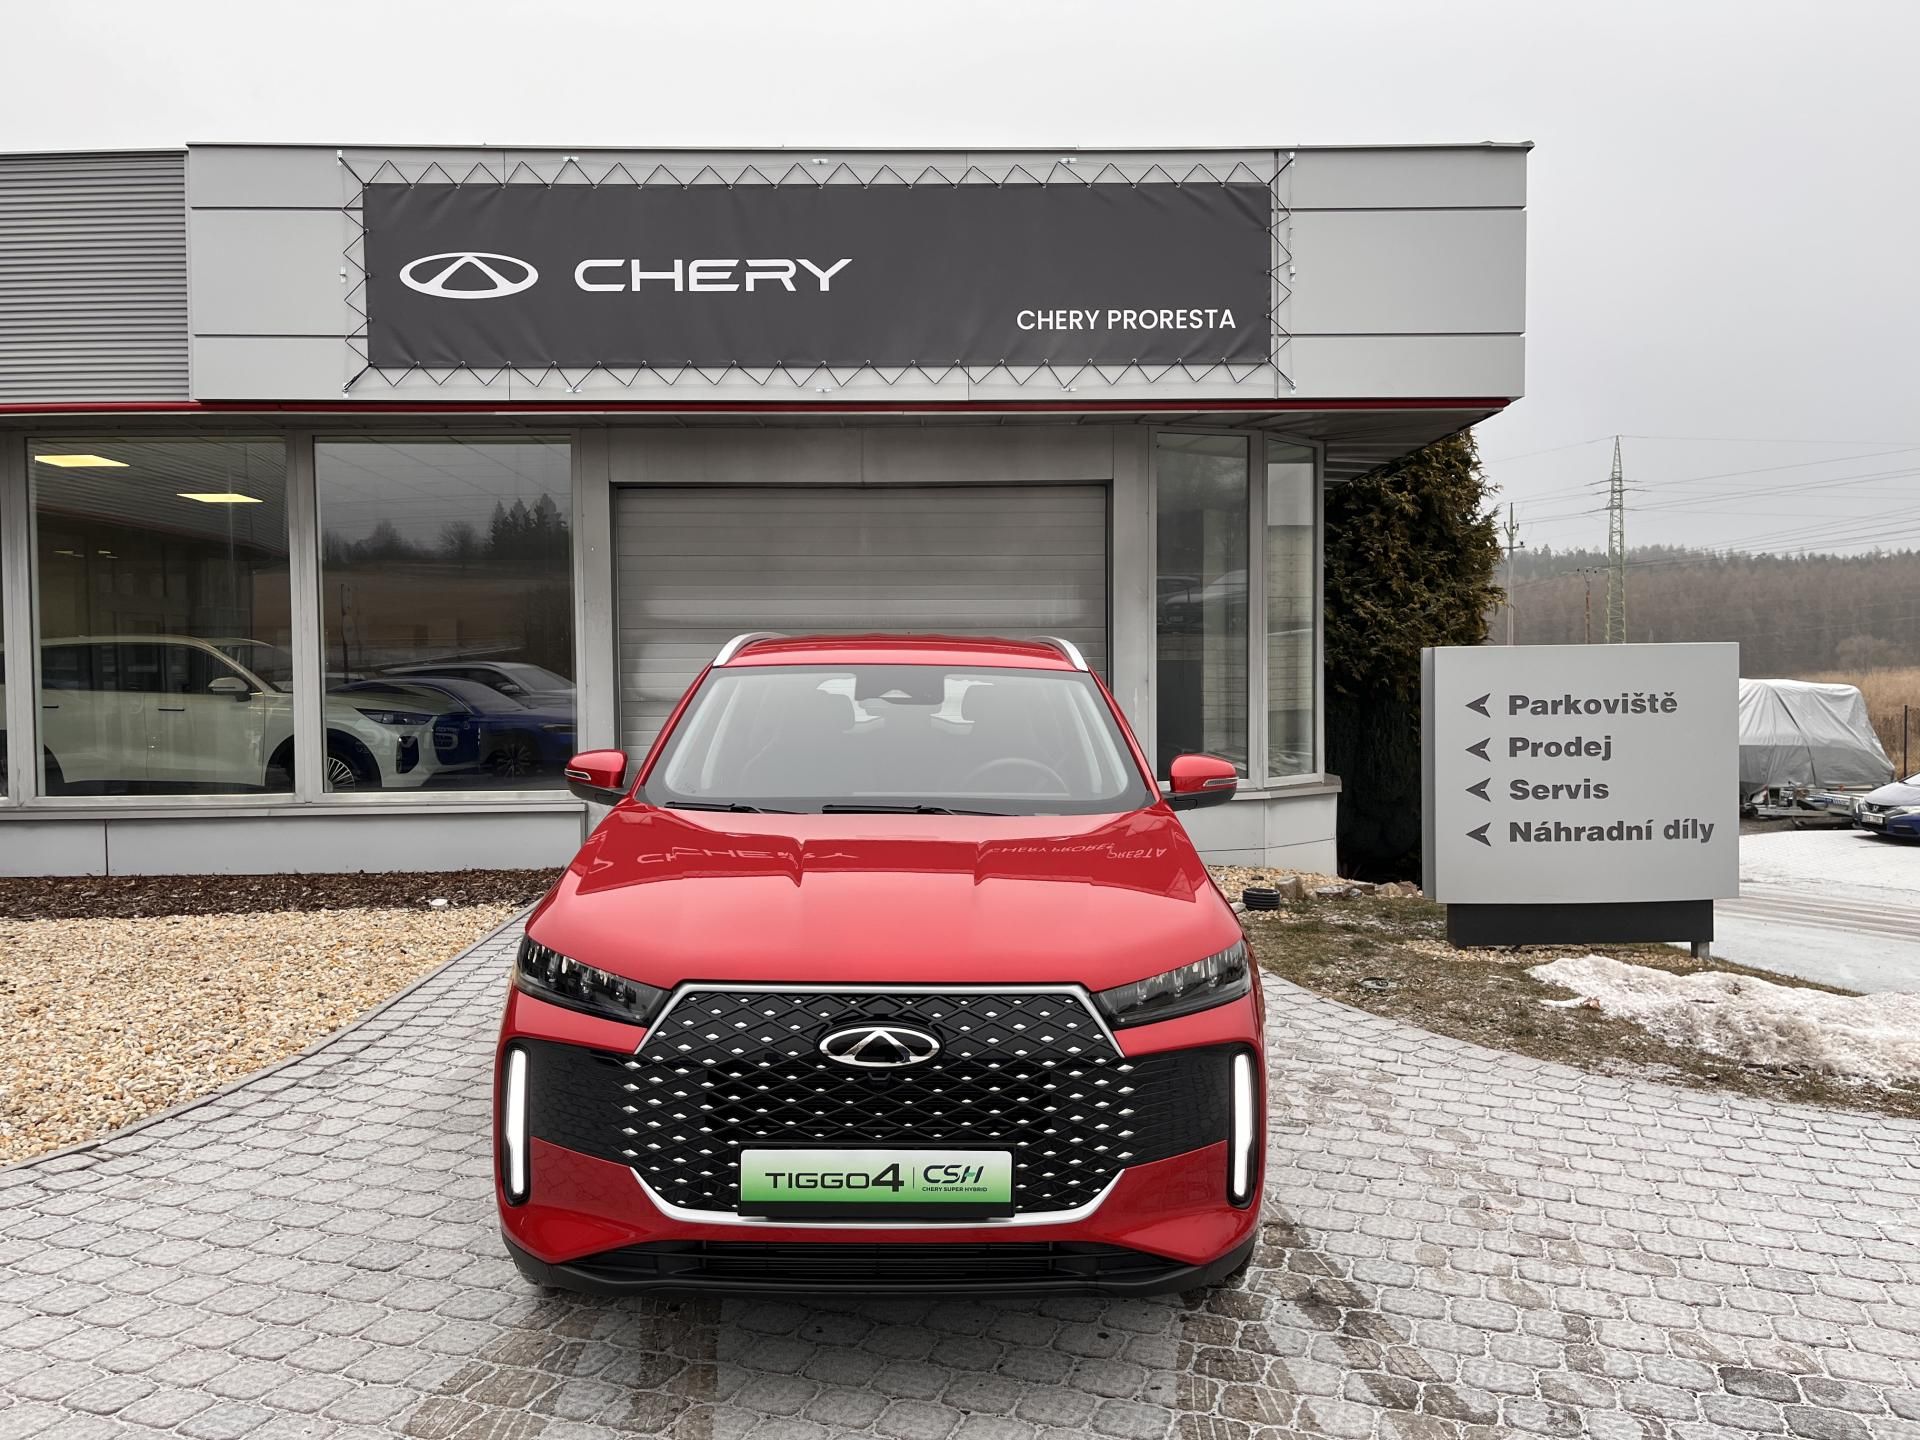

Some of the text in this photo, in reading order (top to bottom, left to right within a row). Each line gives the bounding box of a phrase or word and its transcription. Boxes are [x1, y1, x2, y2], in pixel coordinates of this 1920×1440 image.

[574, 258, 853, 292] CHERY
[1016, 308, 1237, 331] CHERY PRORESTA
[1508, 691, 1678, 716] Parkoviště
[1508, 735, 1613, 761] Prodej
[1508, 778, 1610, 801] Servis
[1508, 818, 1715, 844] Náhradní díly
[923, 1164, 985, 1184] CSH
